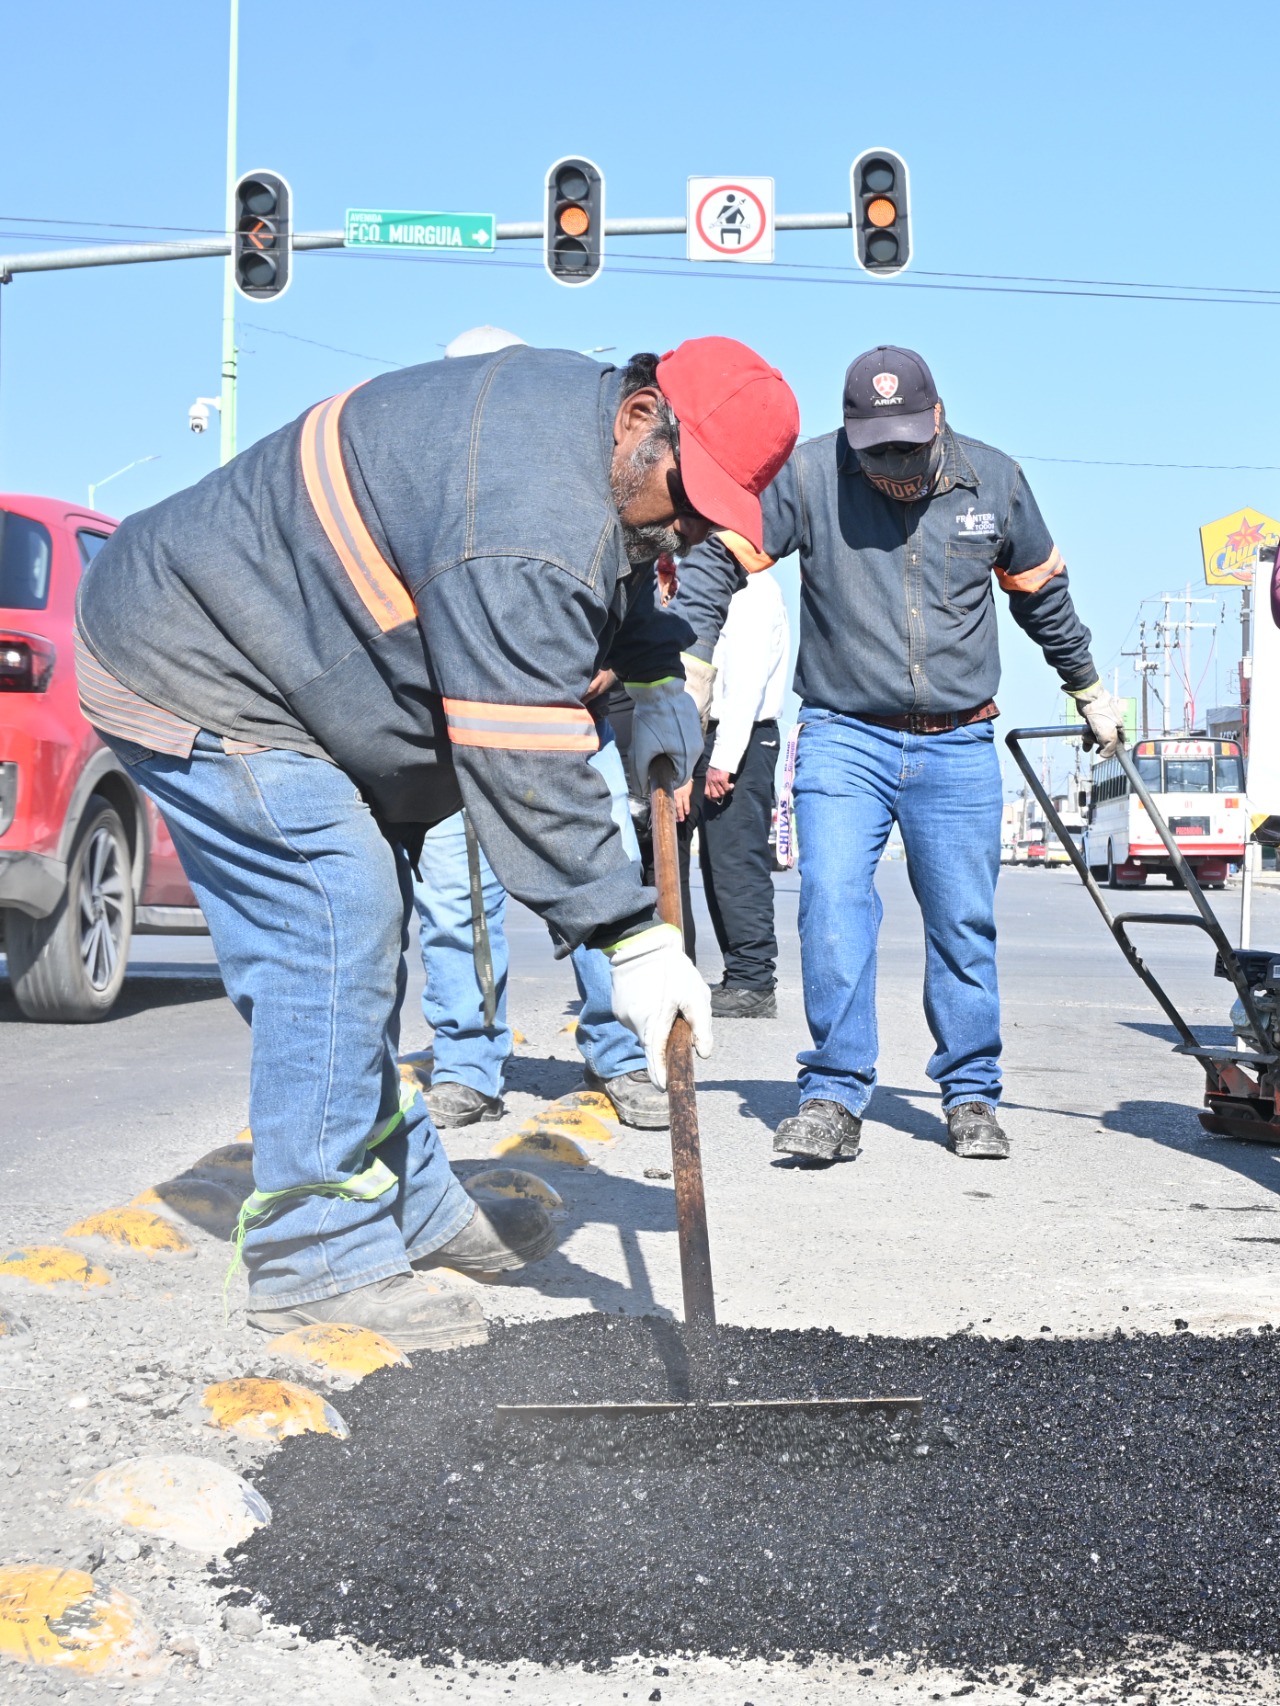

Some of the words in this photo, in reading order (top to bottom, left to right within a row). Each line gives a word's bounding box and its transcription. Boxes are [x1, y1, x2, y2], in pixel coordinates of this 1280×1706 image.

[350, 213, 382, 222] AVENIDA
[349, 223, 383, 243] FCO.
[389, 224, 462, 246] MURGUIA
[874, 397, 902, 406] ARIAT
[779, 800, 789, 855] CHIVAS
